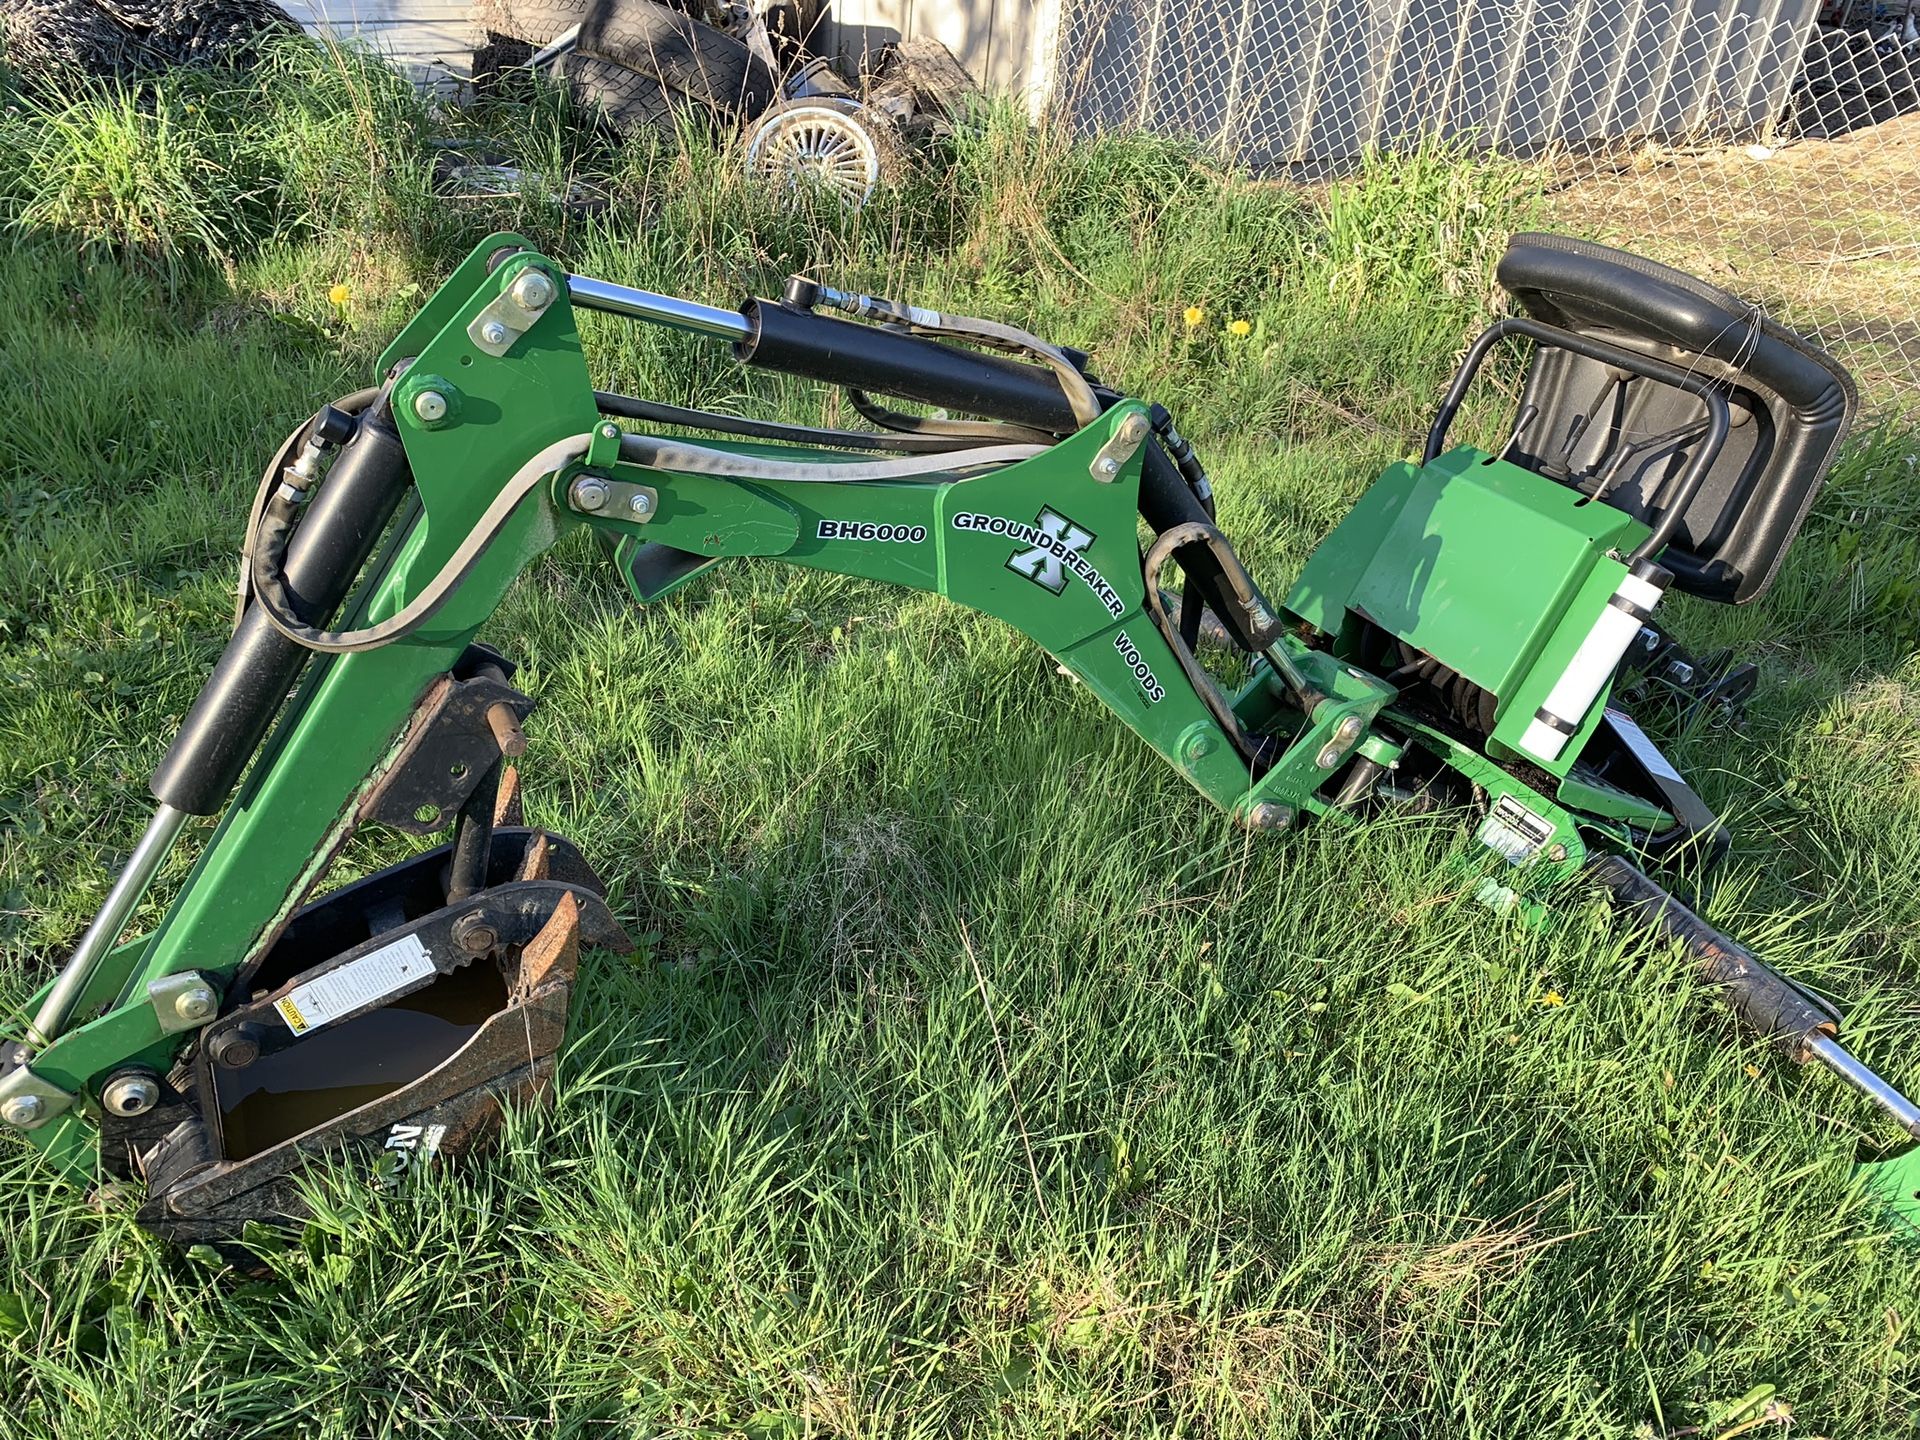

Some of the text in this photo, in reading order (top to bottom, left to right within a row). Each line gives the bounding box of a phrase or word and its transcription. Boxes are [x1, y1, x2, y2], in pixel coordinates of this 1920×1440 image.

[817, 520, 927, 543] BH6000
[952, 511, 1126, 619] GROUNDBREAKER
[1113, 630, 1165, 703] WOODS
[280, 997, 302, 1028] CAUTION
